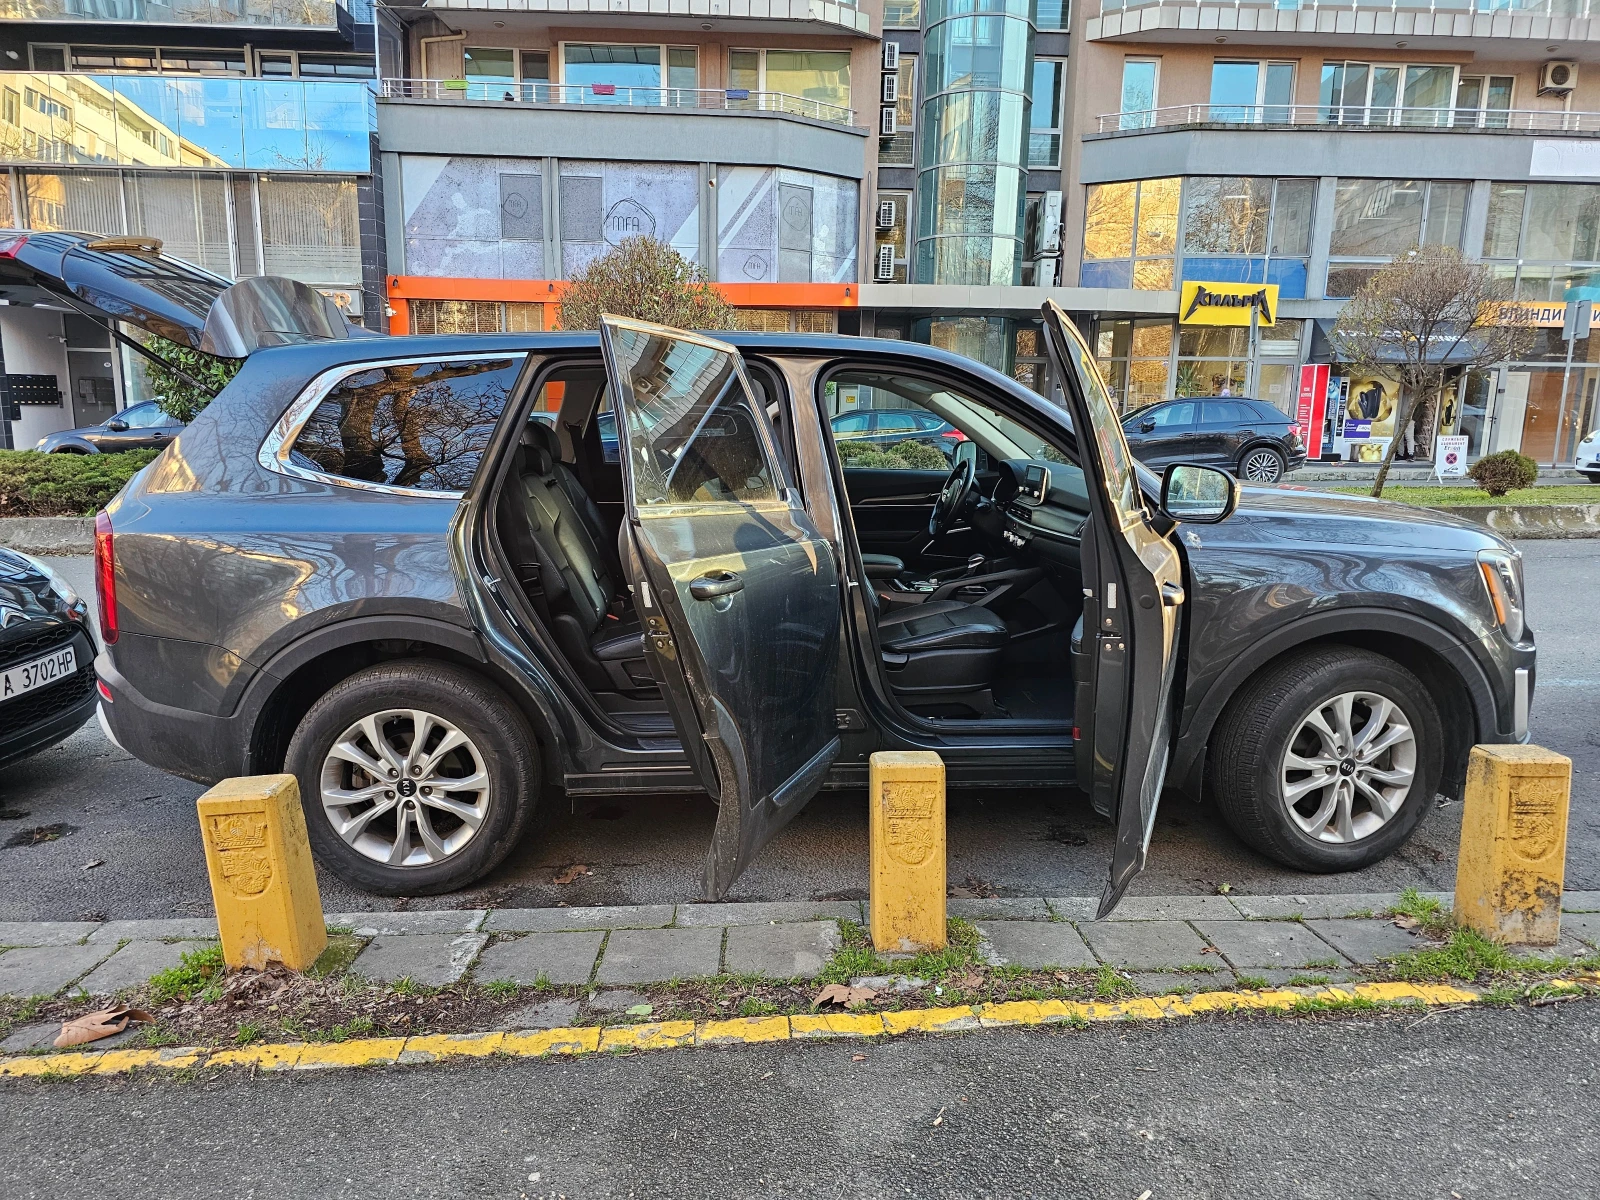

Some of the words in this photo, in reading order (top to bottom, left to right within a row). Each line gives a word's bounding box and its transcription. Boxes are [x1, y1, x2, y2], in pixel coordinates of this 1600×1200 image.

[612, 215, 640, 231] MFA
[748, 261, 761, 270] MFA
[4, 674, 14, 696] A
[22, 658, 57, 689] 3702
[57, 651, 73, 675] HP
[1341, 762, 1354, 773] KIA
[402, 780, 411, 796] KIA
